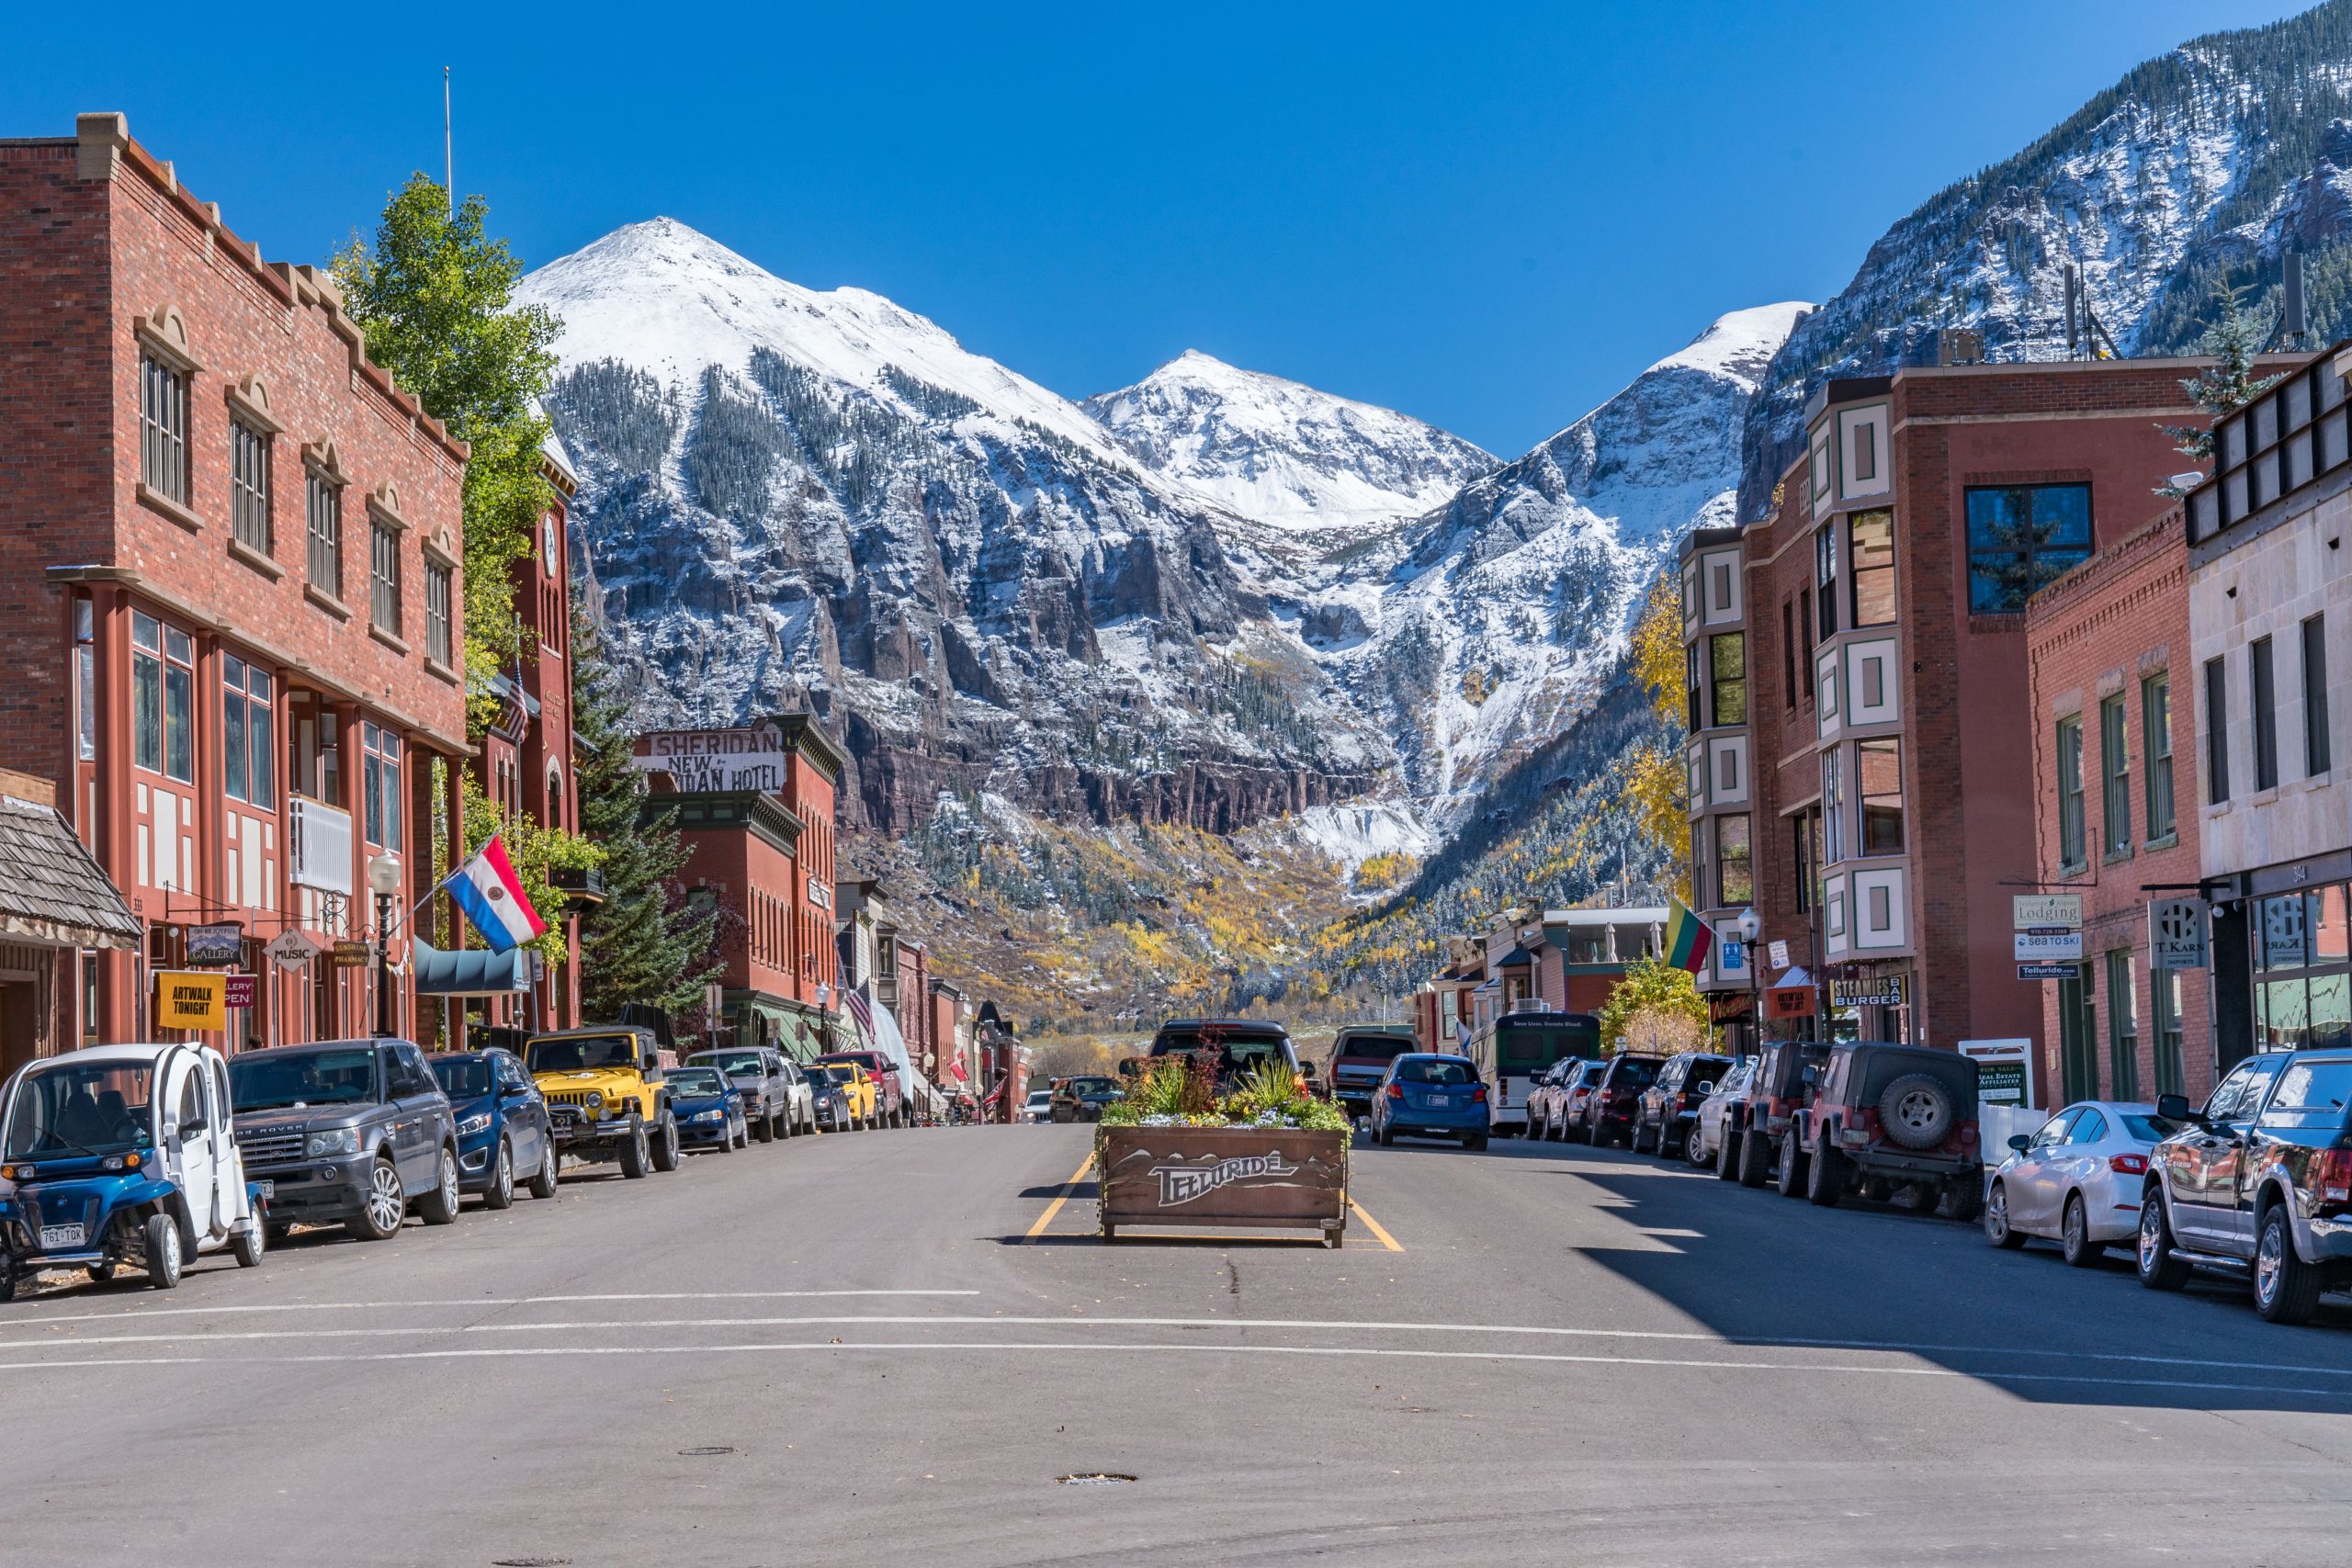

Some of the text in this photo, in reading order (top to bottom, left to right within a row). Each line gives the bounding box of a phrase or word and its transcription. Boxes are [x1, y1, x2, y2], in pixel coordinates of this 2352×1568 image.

[657, 734, 777, 757] SHERIDAN
[668, 756, 712, 774] NEW
[731, 764, 781, 793] HOTEL
[2293, 865, 2305, 882] 394
[2019, 906, 2077, 921] Lodging
[334, 943, 368, 953] SUNSHINE
[2029, 937, 2079, 946] sea TO SKI
[192, 949, 235, 960] GALLERY
[275, 949, 311, 960] MUSIC
[334, 954, 368, 964] PHARMACY
[173, 986, 212, 1001] ARTWALK
[1835, 978, 1889, 997] STEAMIES
[224, 994, 250, 1003] PEN
[1836, 996, 1901, 1006] BURGER
[174, 1000, 210, 1015] TONIGHT
[1148, 1155, 1300, 1208] TELLURIDE
